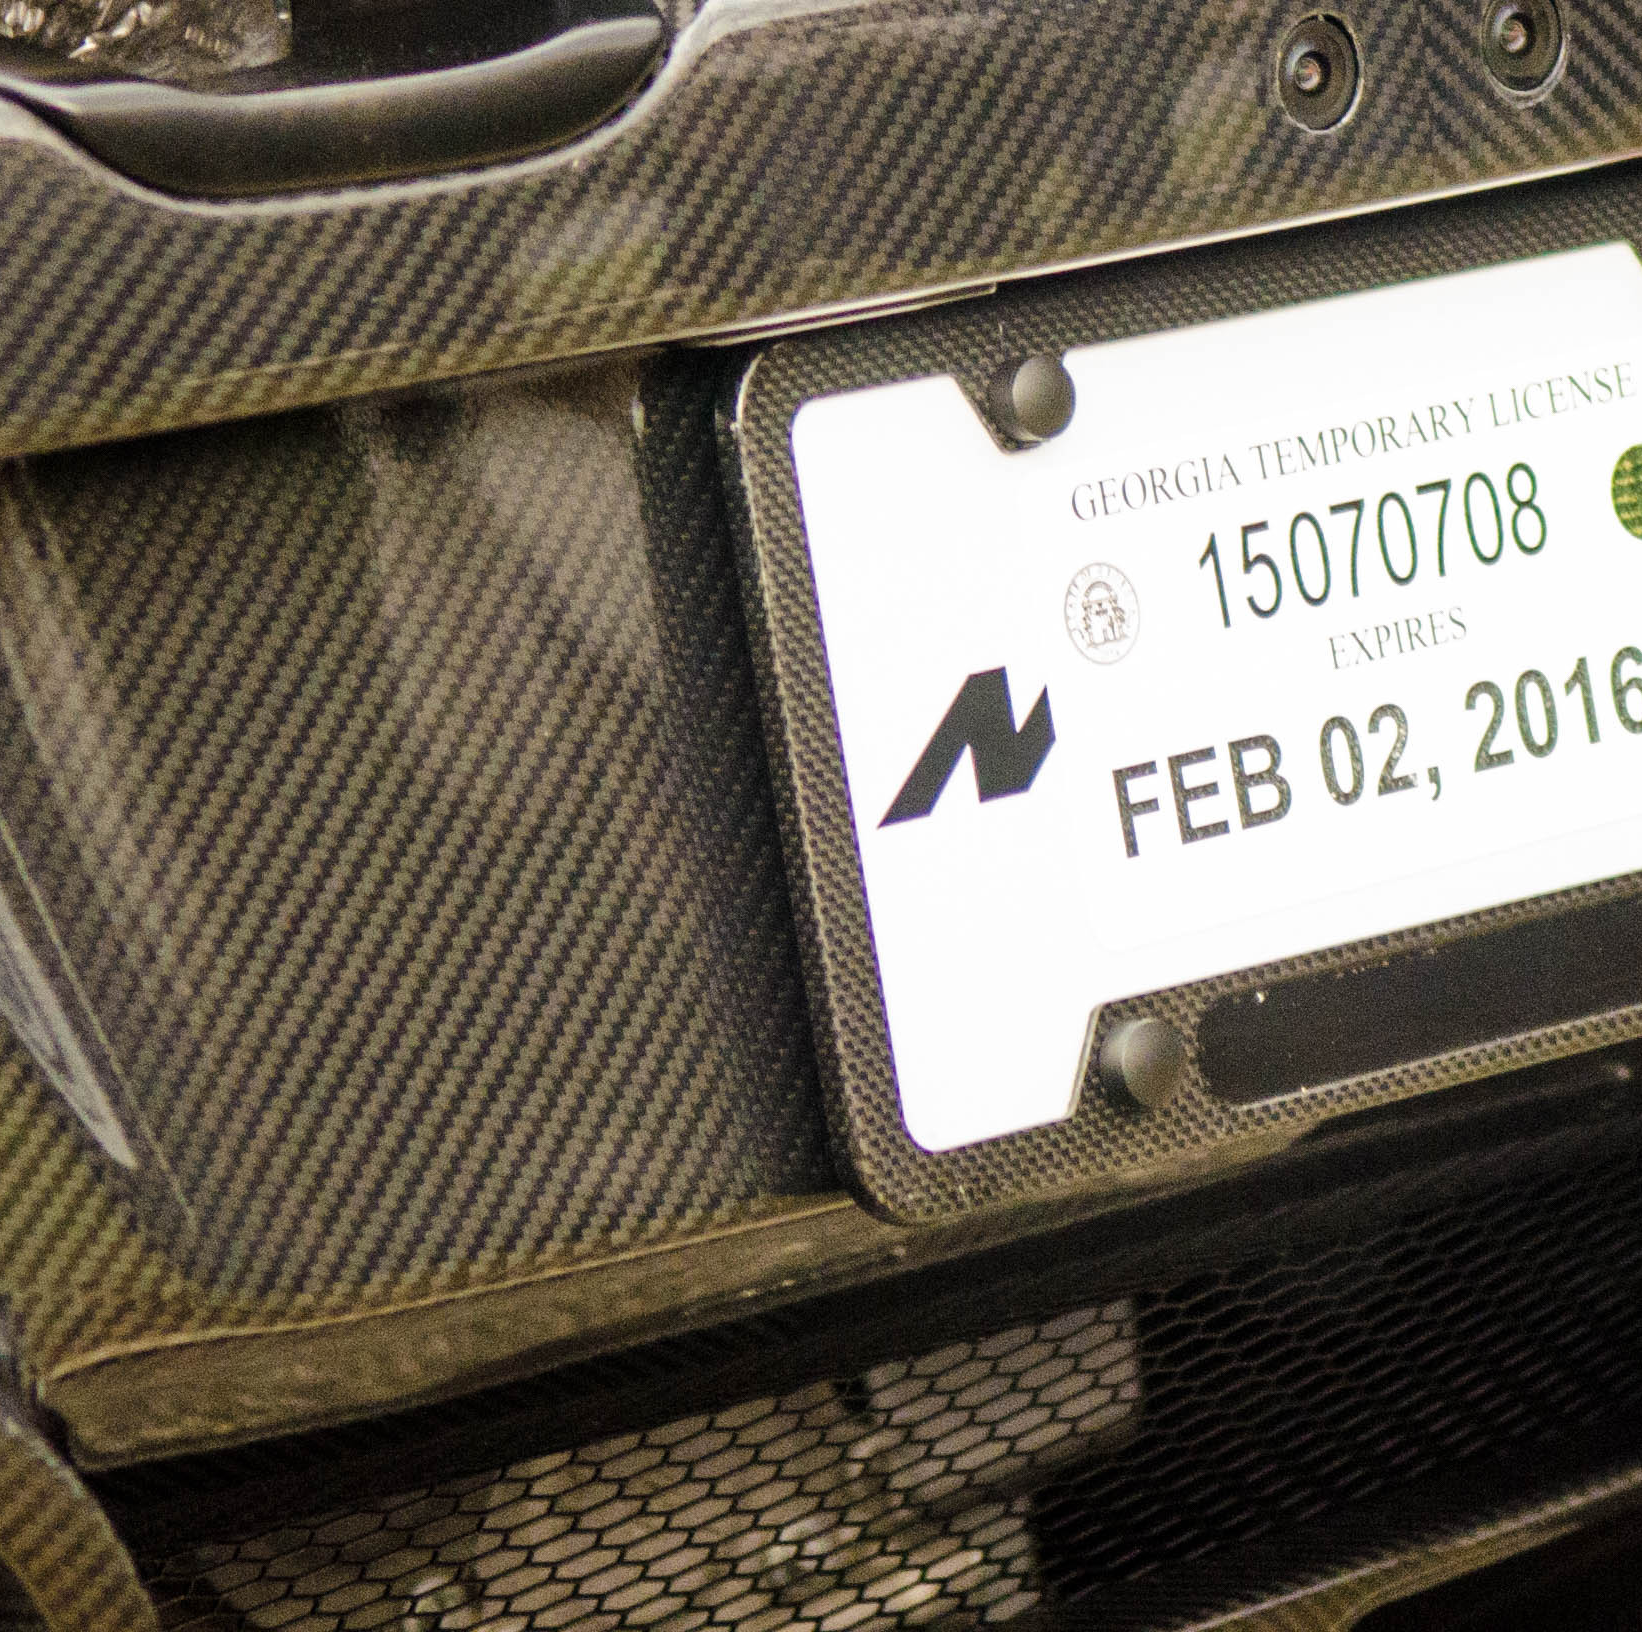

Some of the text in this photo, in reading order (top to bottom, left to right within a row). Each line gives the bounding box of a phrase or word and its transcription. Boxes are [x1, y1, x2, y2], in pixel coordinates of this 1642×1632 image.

[1070, 362, 1637, 522] GEORGIA TEMPORARY LICENSE
[1198, 462, 1547, 629] 15070708
[1327, 606, 1468, 670] EXPIRES
[1111, 733, 1292, 858] FEB
[1318, 703, 1443, 807] 02,
